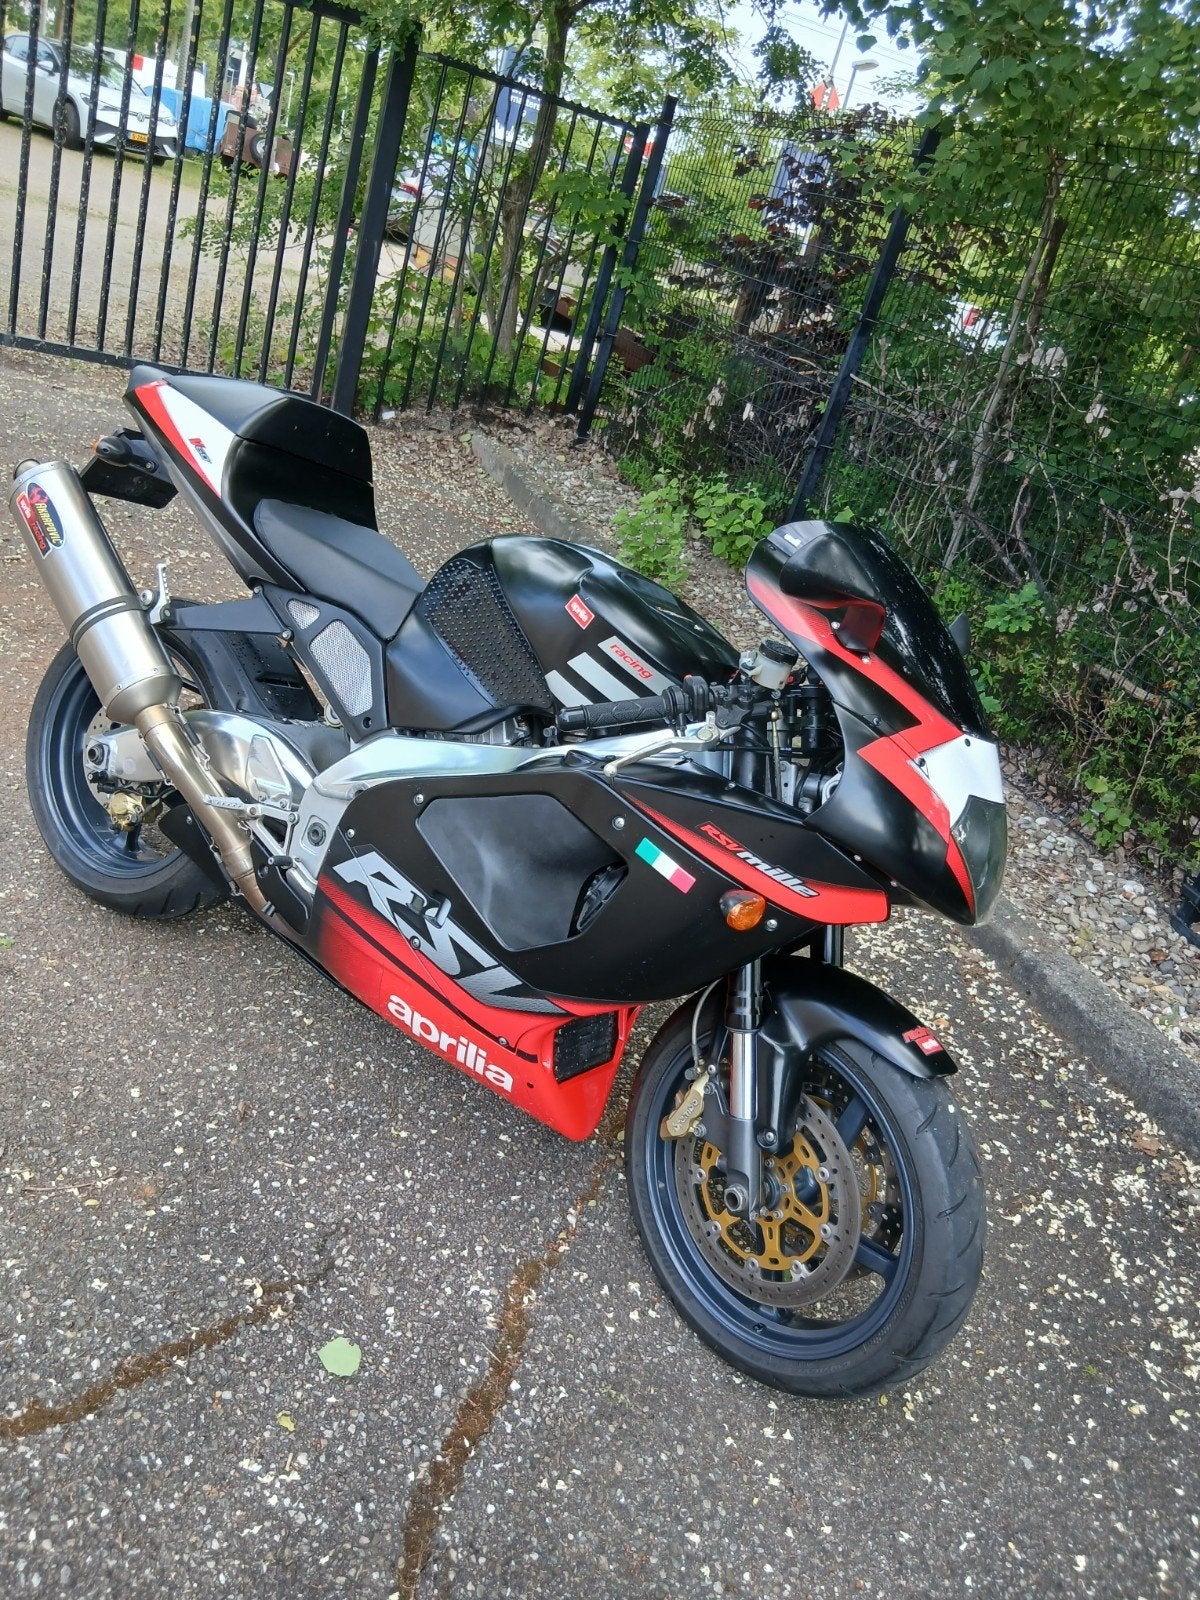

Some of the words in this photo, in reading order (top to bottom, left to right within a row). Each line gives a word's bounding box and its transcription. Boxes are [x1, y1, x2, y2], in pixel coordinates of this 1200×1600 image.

[570, 601, 590, 623] aprilia
[609, 643, 654, 679] racing
[386, 994, 514, 1093] aprilia
